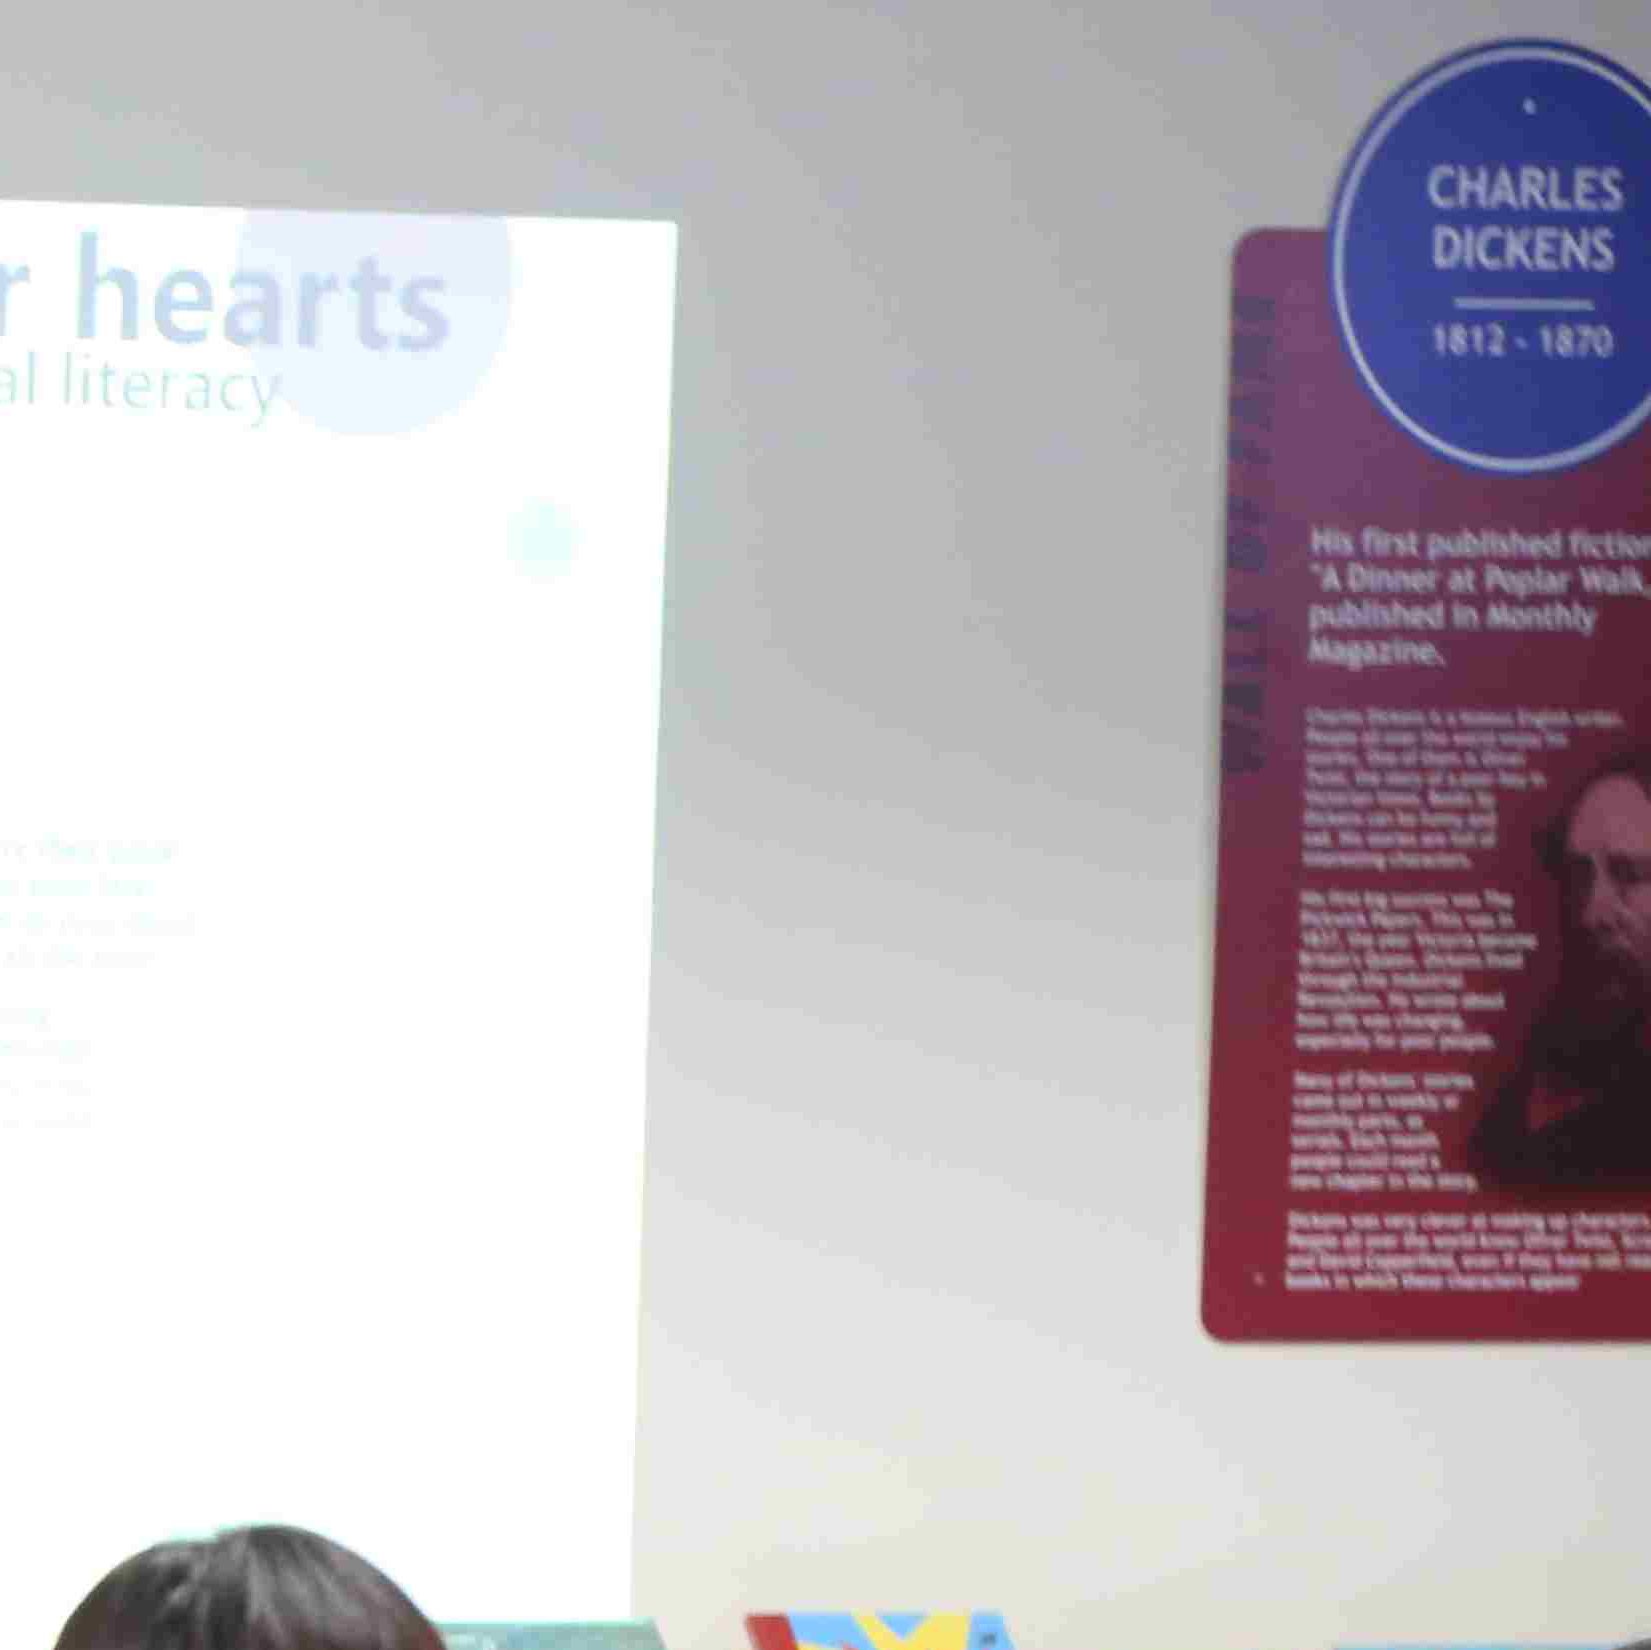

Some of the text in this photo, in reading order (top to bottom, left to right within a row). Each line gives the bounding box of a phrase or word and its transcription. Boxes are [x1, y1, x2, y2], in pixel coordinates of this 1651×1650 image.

[1427, 164, 1625, 213] CHARLES
[1431, 224, 1616, 273] DICKENS
[74, 231, 452, 354] hearts
[1431, 323, 1506, 357] 1812
[1540, 324, 1615, 358] 1870
[60, 350, 284, 429] literacy
